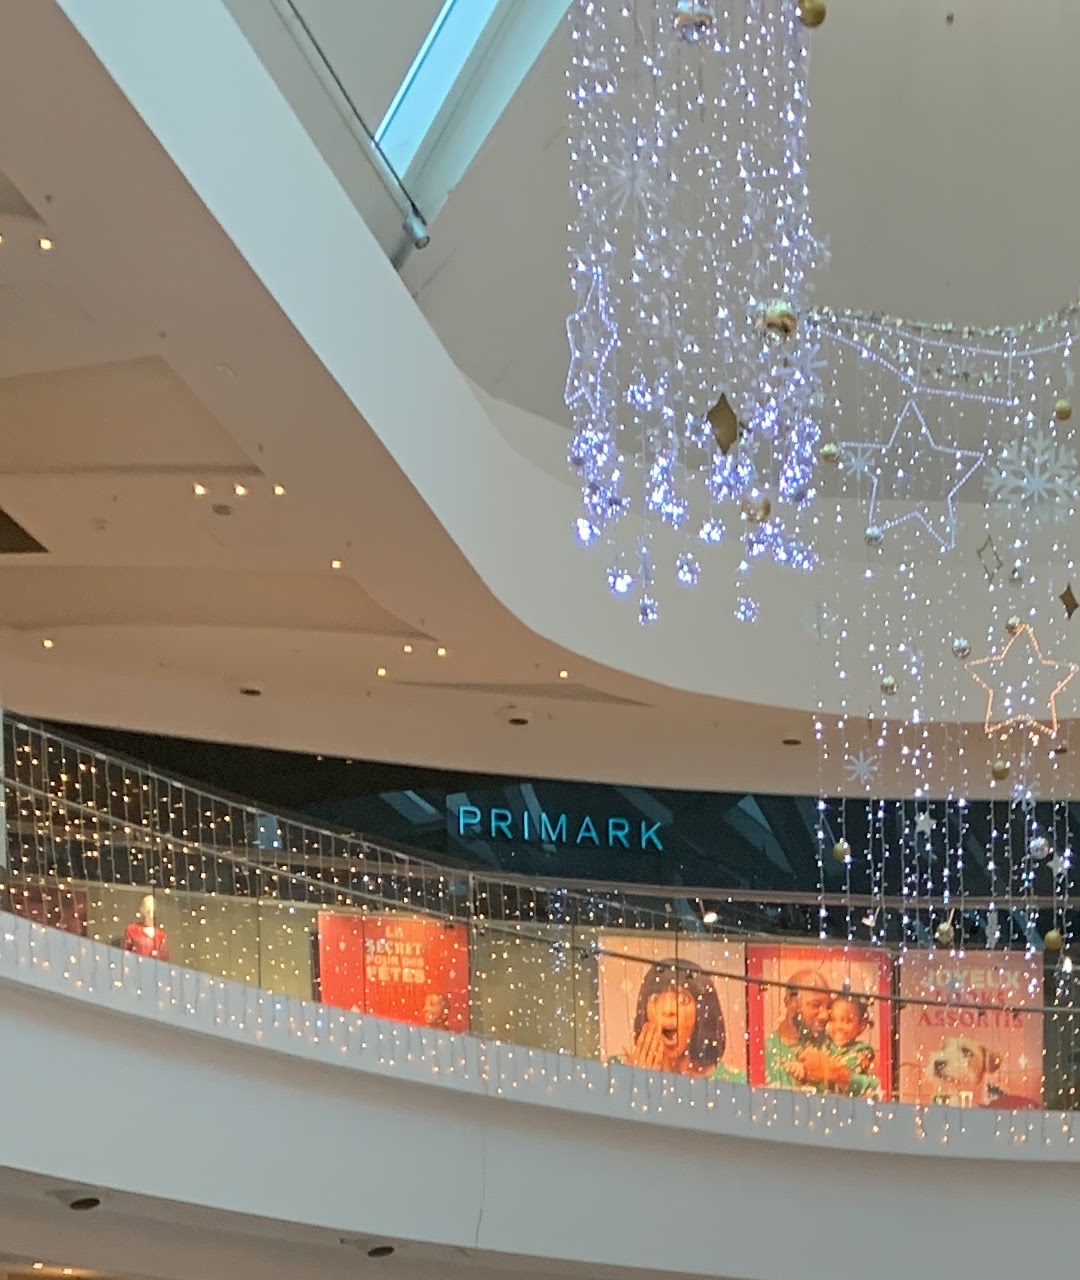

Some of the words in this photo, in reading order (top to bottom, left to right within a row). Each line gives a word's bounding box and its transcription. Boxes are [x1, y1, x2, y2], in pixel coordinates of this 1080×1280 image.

[458, 805, 665, 852] PRIMARK
[920, 969, 1019, 989] JOYEUX
[918, 1009, 1023, 1028] ASSORTIS
